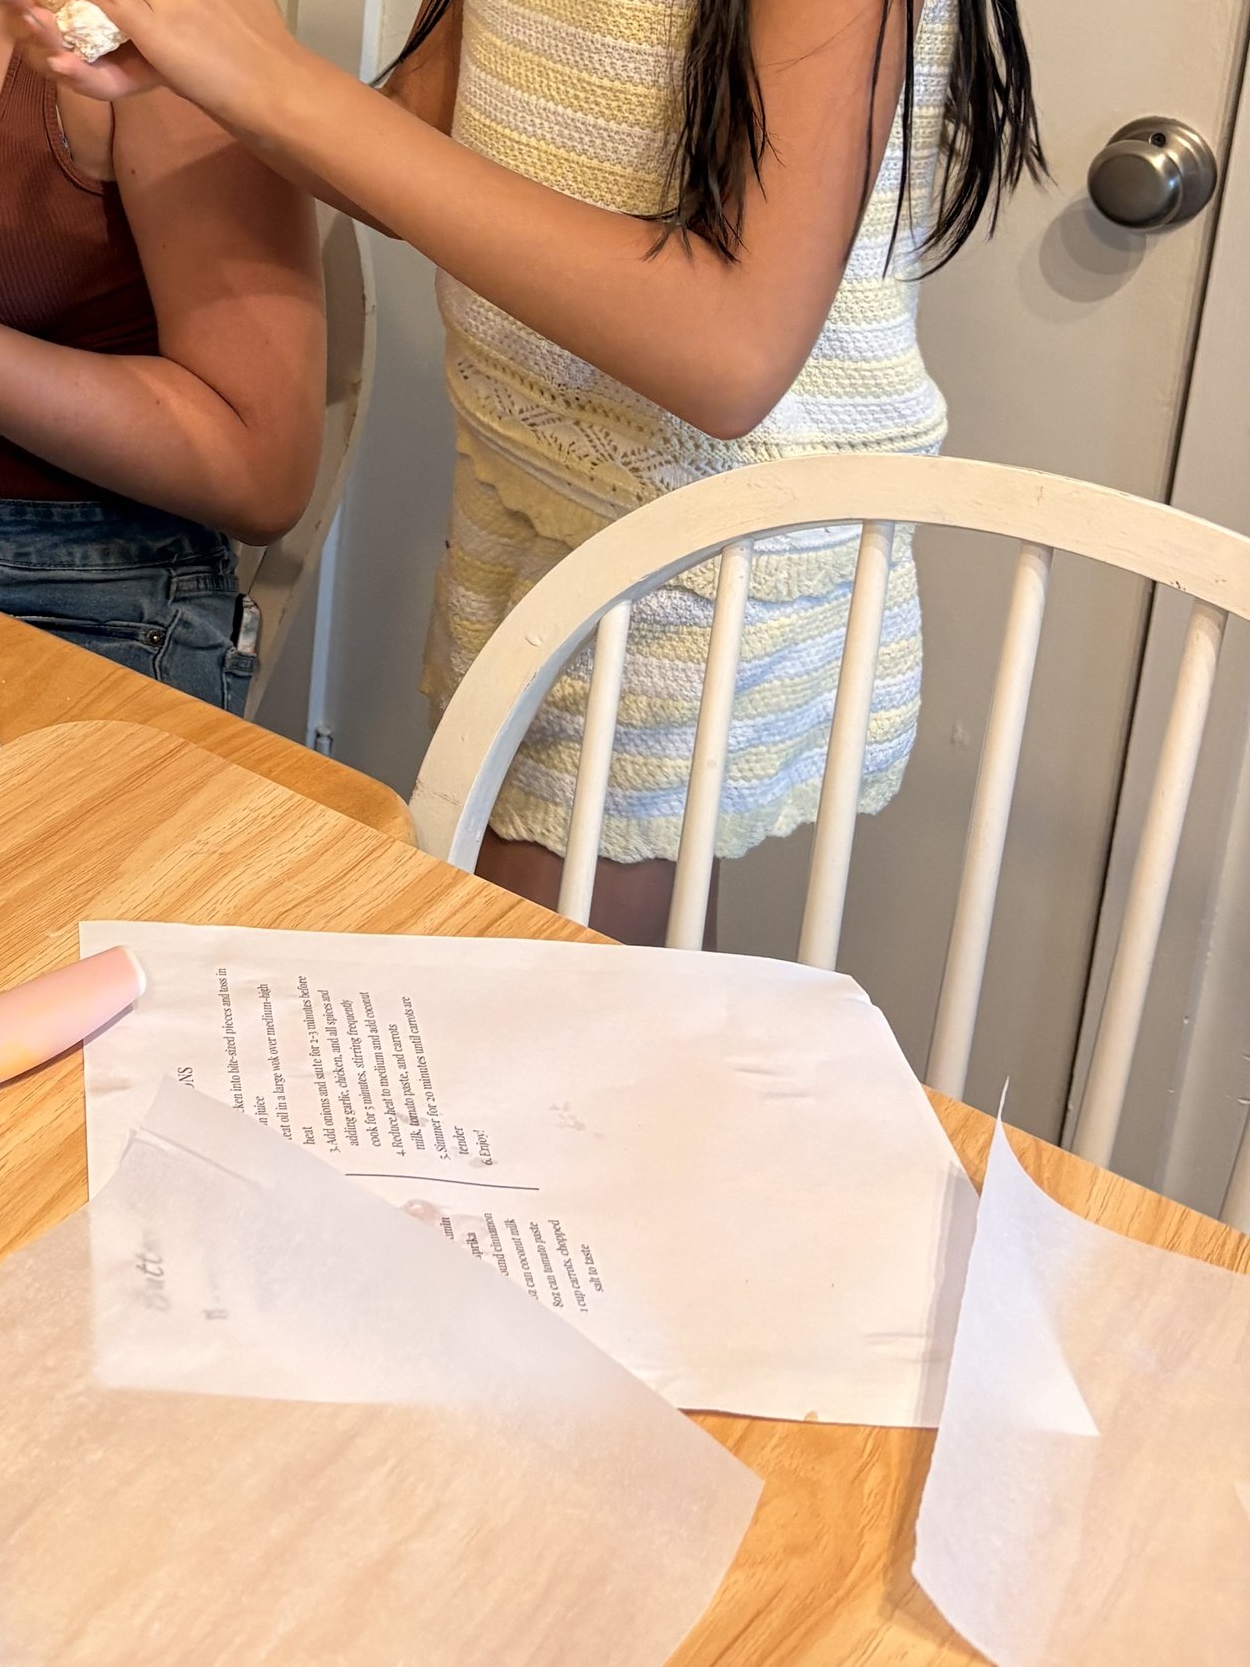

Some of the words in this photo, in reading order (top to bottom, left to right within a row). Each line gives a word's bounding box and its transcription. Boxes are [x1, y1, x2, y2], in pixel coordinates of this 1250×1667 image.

[216, 968, 227, 976] in
[217, 978, 228, 992] toss
[297, 976, 310, 999] before
[220, 993, 230, 1007] and
[318, 990, 330, 1002] and
[359, 992, 374, 1018] coconut
[402, 996, 412, 1007] are
[257, 983, 275, 1036] medium-high
[301, 1000, 315, 1030] minutes
[322, 1002, 337, 1025] spices
[340, 999, 359, 1036] frequently
[223, 1008, 235, 1035] pieces
[365, 1020, 378, 1033] add
[404, 1008, 419, 1034] carrots
[308, 1032, 319, 1043] 2-3
[325, 1027, 338, 1036] all
[388, 1024, 403, 1052] carrots
[268, 1037, 277, 1054] over
[309, 1045, 321, 1056] for
[326, 1038, 341, 1053] and
[368, 1035, 382, 1050] and
[409, 1036, 424, 1054] until
[223, 1037, 239, 1073] bite-sized
[349, 1037, 365, 1068] stirring
[392, 1054, 406, 1069] and
[267, 1056, 280, 1071] wok
[332, 1054, 348, 1088] chicken,
[372, 1052, 388, 1087] medium
[417, 1056, 432, 1090] minutes
[177, 1066, 194, 1088] NS
[230, 1075, 242, 1091] into
[273, 1073, 285, 1093] large
[399, 1071, 415, 1096] paste,
[315, 1082, 328, 1096] and
[357, 1070, 372, 1104] minutes,
[233, 1094, 244, 1113] ken
[254, 1096, 268, 1115] juice
[275, 1102, 287, 1110] in
[338, 1090, 354, 1115] garlic,
[425, 1092, 435, 1102] 20
[319, 1098, 334, 1126] onions
[383, 1099, 395, 1115] heat
[404, 1098, 420, 1126] tomato
[427, 1104, 439, 1117] for
[276, 1112, 289, 1122] oil
[364, 1113, 376, 1125] for
[280, 1125, 292, 1140] eat
[302, 1126, 315, 1145] heat
[344, 1117, 359, 1146] adding
[367, 1127, 381, 1147] cook
[387, 1117, 403, 1148] Reduce
[410, 1129, 425, 1150] milk,
[431, 1119, 447, 1153] Simmer
[453, 1126, 469, 1154] tender
[473, 1130, 490, 1156] Enjoy!
[484, 1212, 502, 1252] cinnamon
[504, 1218, 519, 1236] milk
[529, 1221, 546, 1243] paste
[548, 1220, 569, 1256] chopped
[512, 1237, 530, 1270] coconut
[537, 1245, 553, 1273] tomato
[580, 1244, 594, 1264] taste
[523, 1272, 535, 1287] can
[588, 1267, 598, 1275] to
[547, 1275, 558, 1290] can
[589, 1277, 604, 1292] salt
[551, 1292, 564, 1307] 8oz
[574, 1290, 586, 1306] cup
